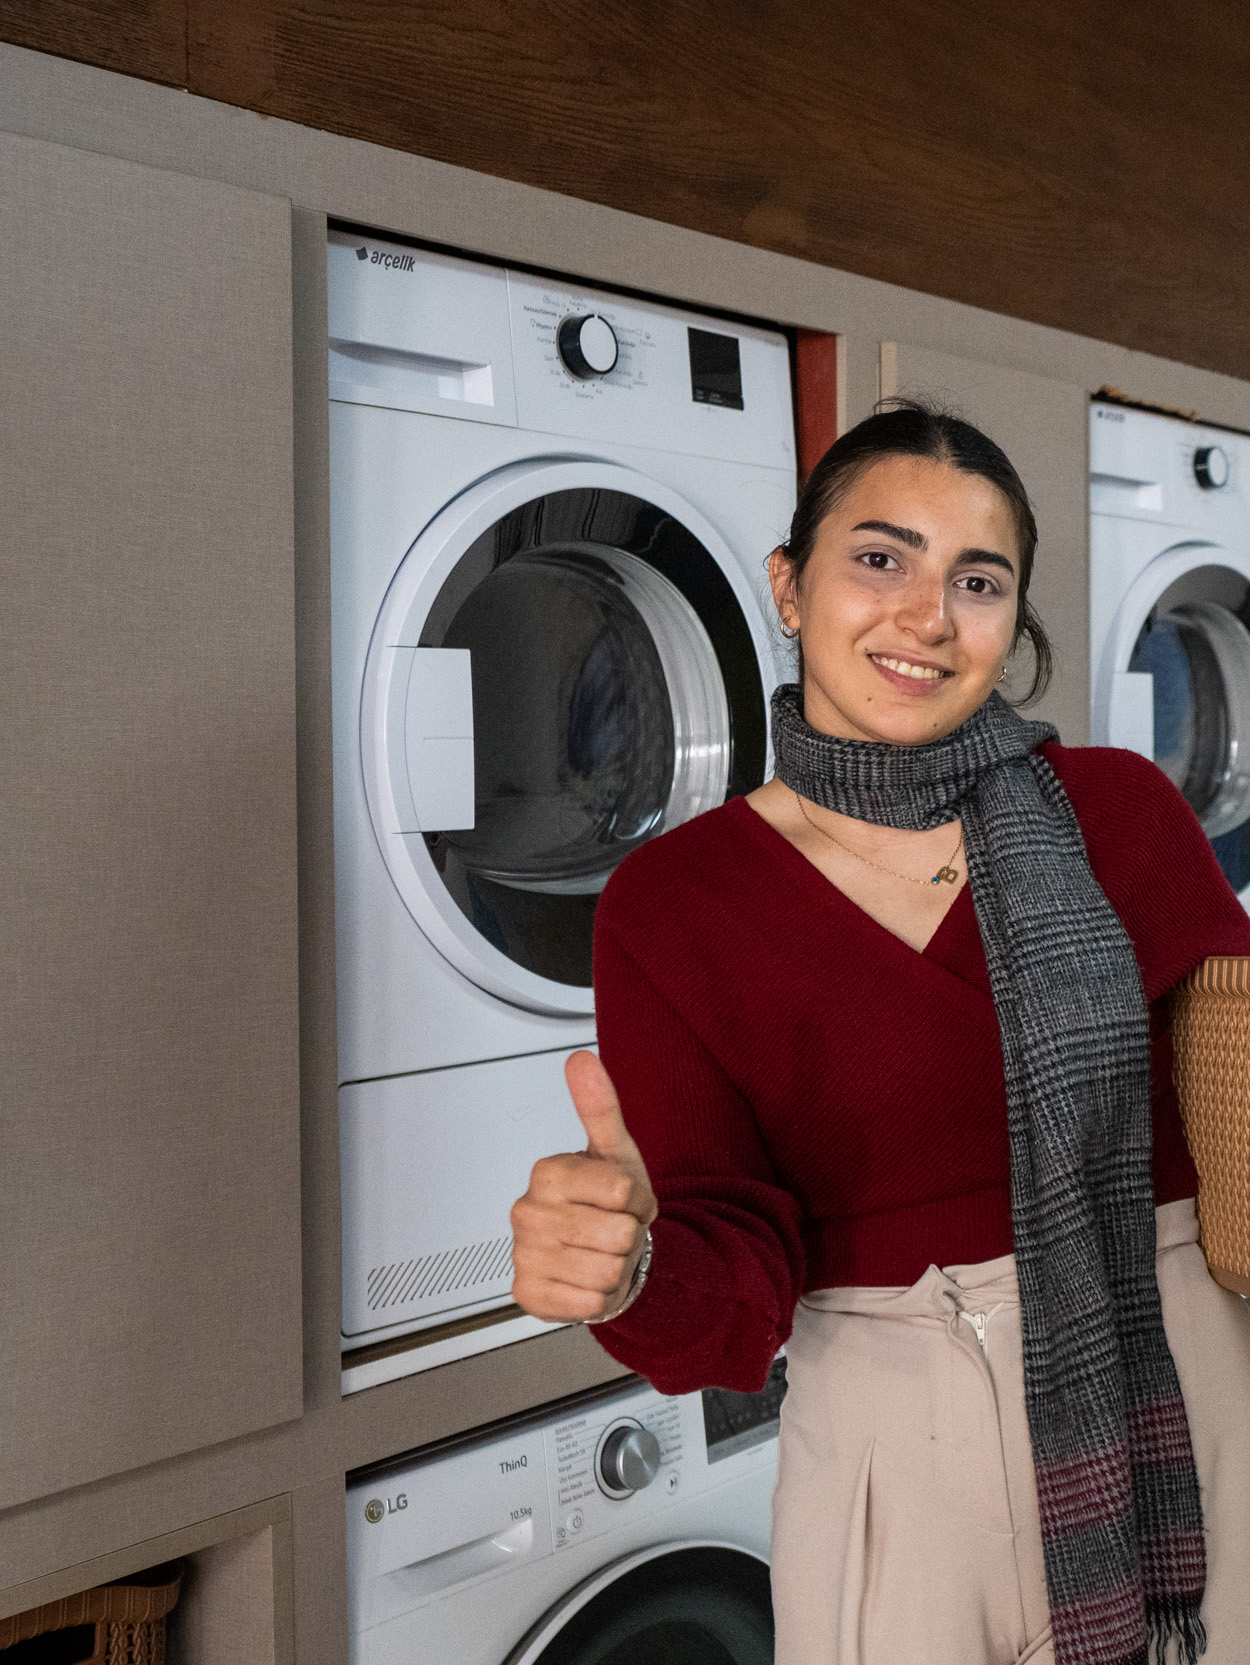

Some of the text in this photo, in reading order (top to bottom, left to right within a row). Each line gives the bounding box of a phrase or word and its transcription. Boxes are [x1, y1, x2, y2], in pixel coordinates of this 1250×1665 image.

[371, 251, 416, 272] arçelik
[499, 1455, 528, 1474] ThinQ
[387, 1493, 409, 1515] LG
[510, 1506, 533, 1521] 10.5kg
